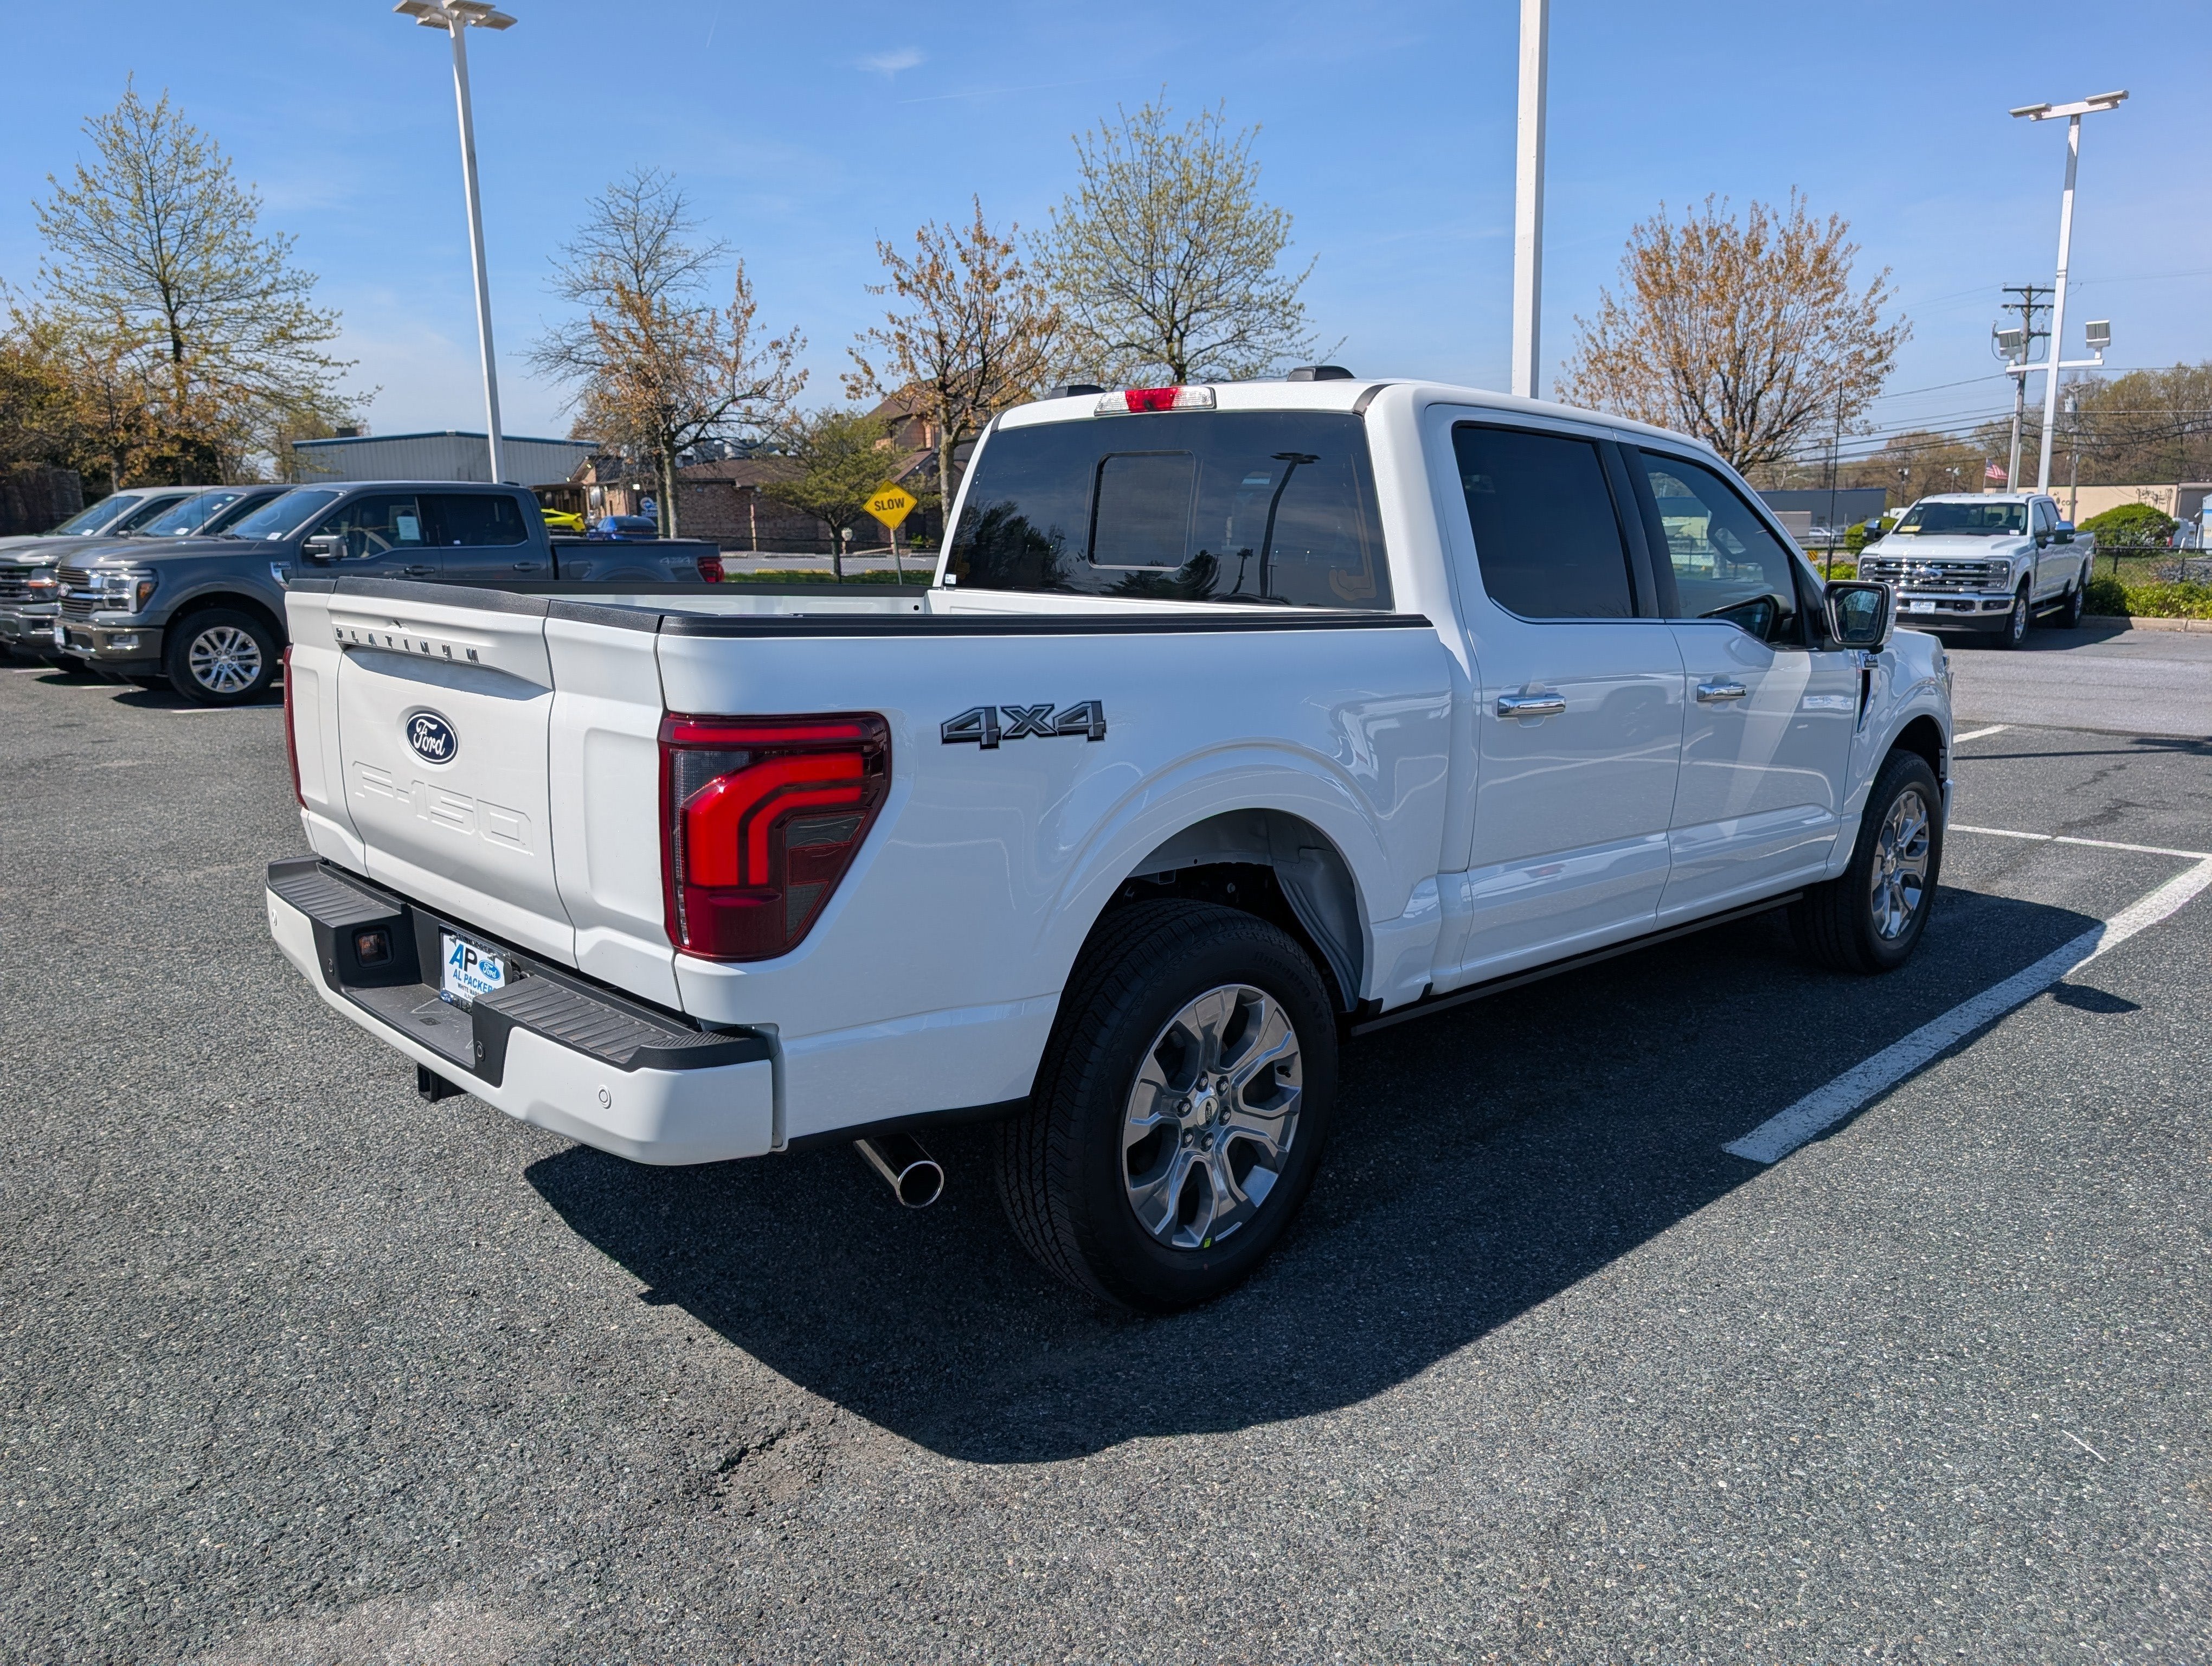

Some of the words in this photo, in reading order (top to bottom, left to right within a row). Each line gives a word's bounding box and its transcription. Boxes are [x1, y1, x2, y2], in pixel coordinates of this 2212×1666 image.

[874, 498, 904, 511] SLOW
[336, 627, 478, 662] PLATINUM
[413, 719, 446, 756] Ford
[352, 760, 534, 856] F-150
[449, 943, 478, 972] AP
[482, 962, 497, 979] Ford
[453, 968, 462, 981] AL
